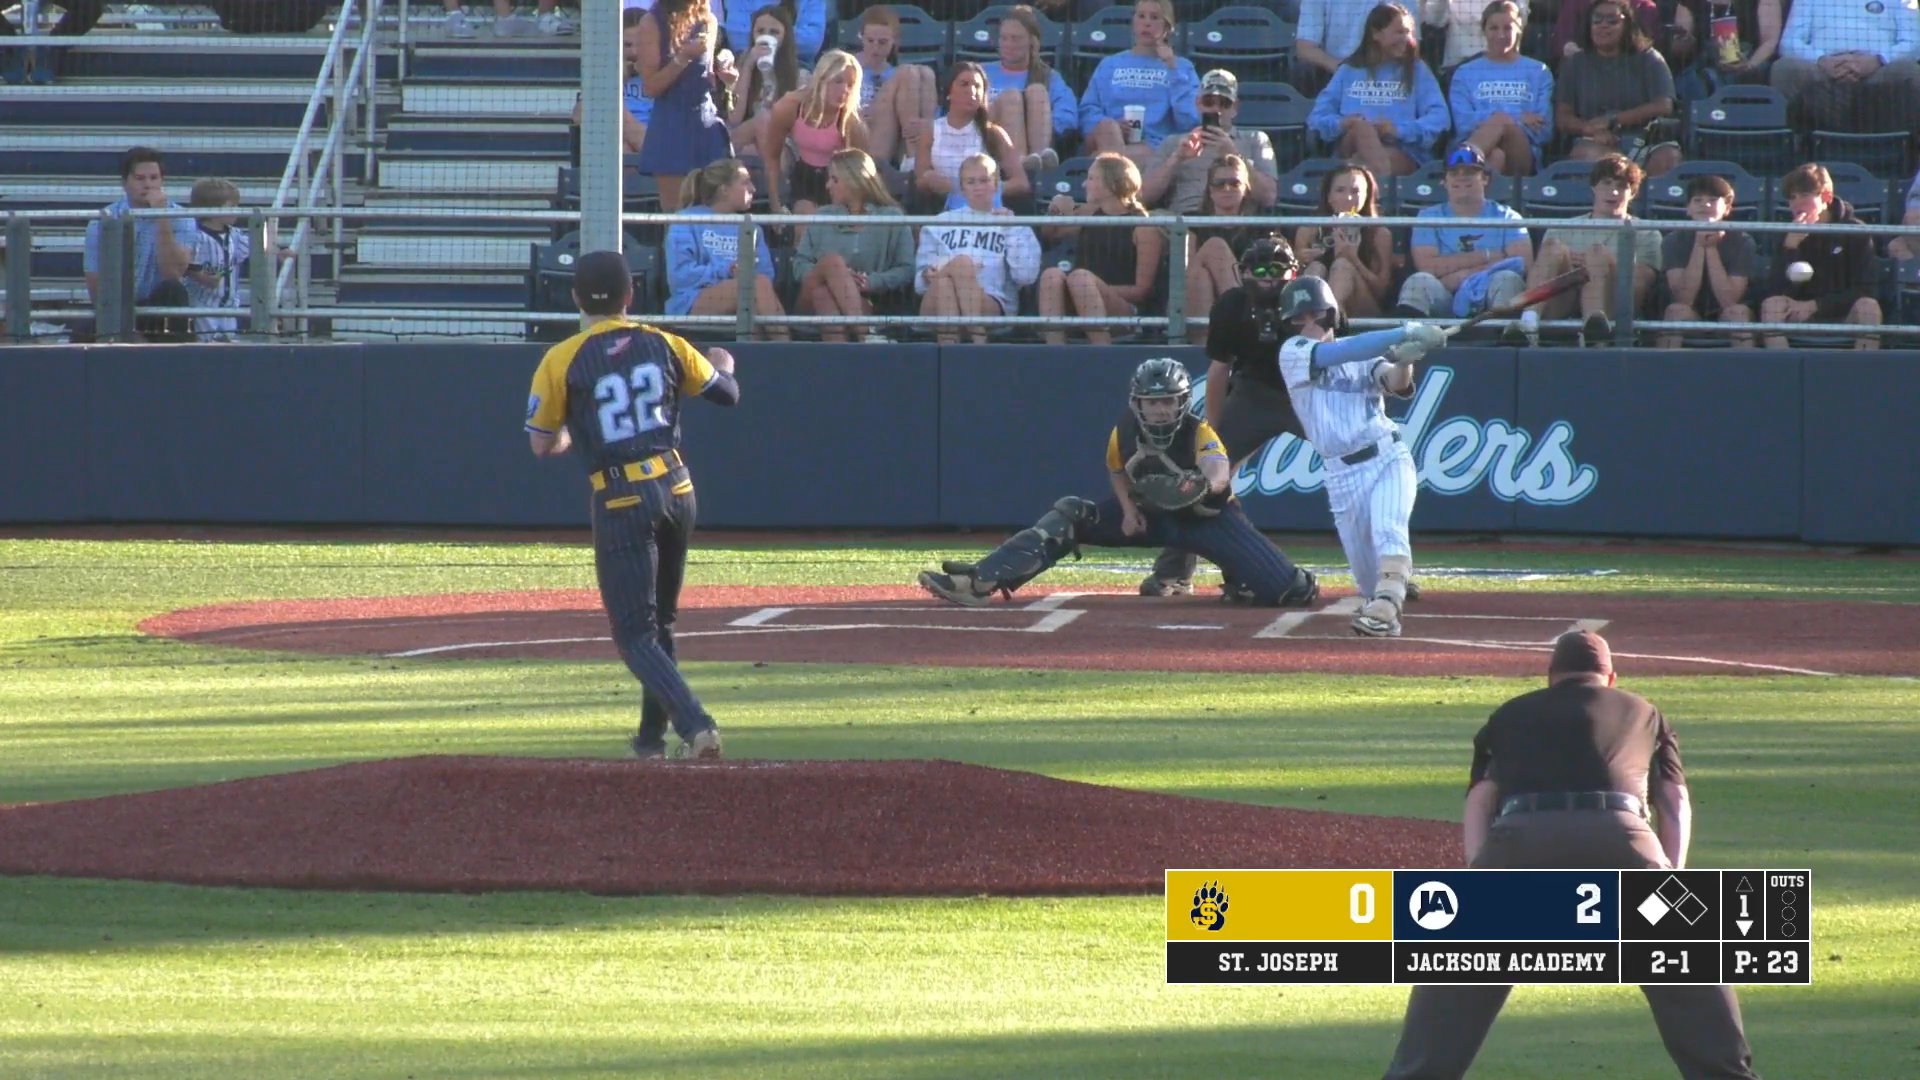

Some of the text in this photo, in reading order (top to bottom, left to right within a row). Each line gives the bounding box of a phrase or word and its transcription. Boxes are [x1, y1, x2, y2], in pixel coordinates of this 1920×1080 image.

[973, 231, 1008, 257] MIS
[594, 362, 670, 443] 22
[1190, 365, 1598, 504] aders
